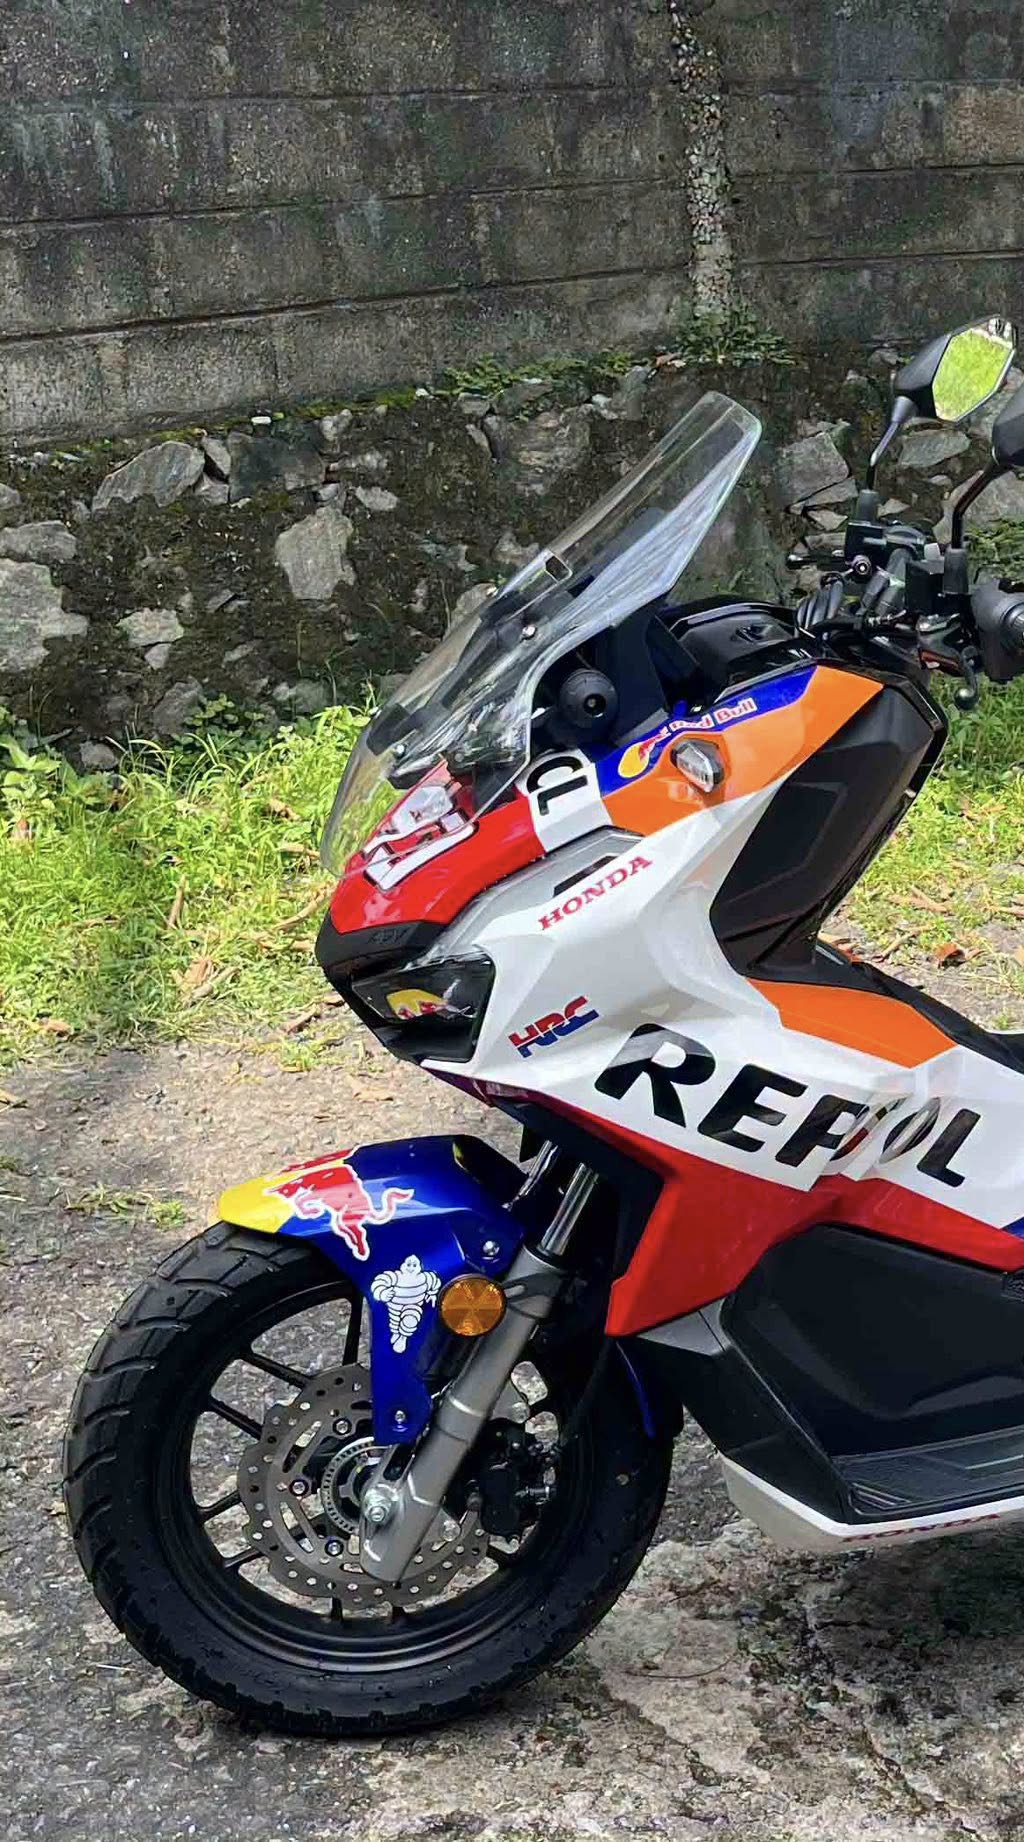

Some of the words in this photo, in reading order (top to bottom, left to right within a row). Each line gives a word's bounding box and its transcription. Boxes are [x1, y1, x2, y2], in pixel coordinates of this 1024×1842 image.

[714, 698, 757, 723] Bull
[538, 855, 653, 930] HONDA
[508, 995, 599, 1058] HRC
